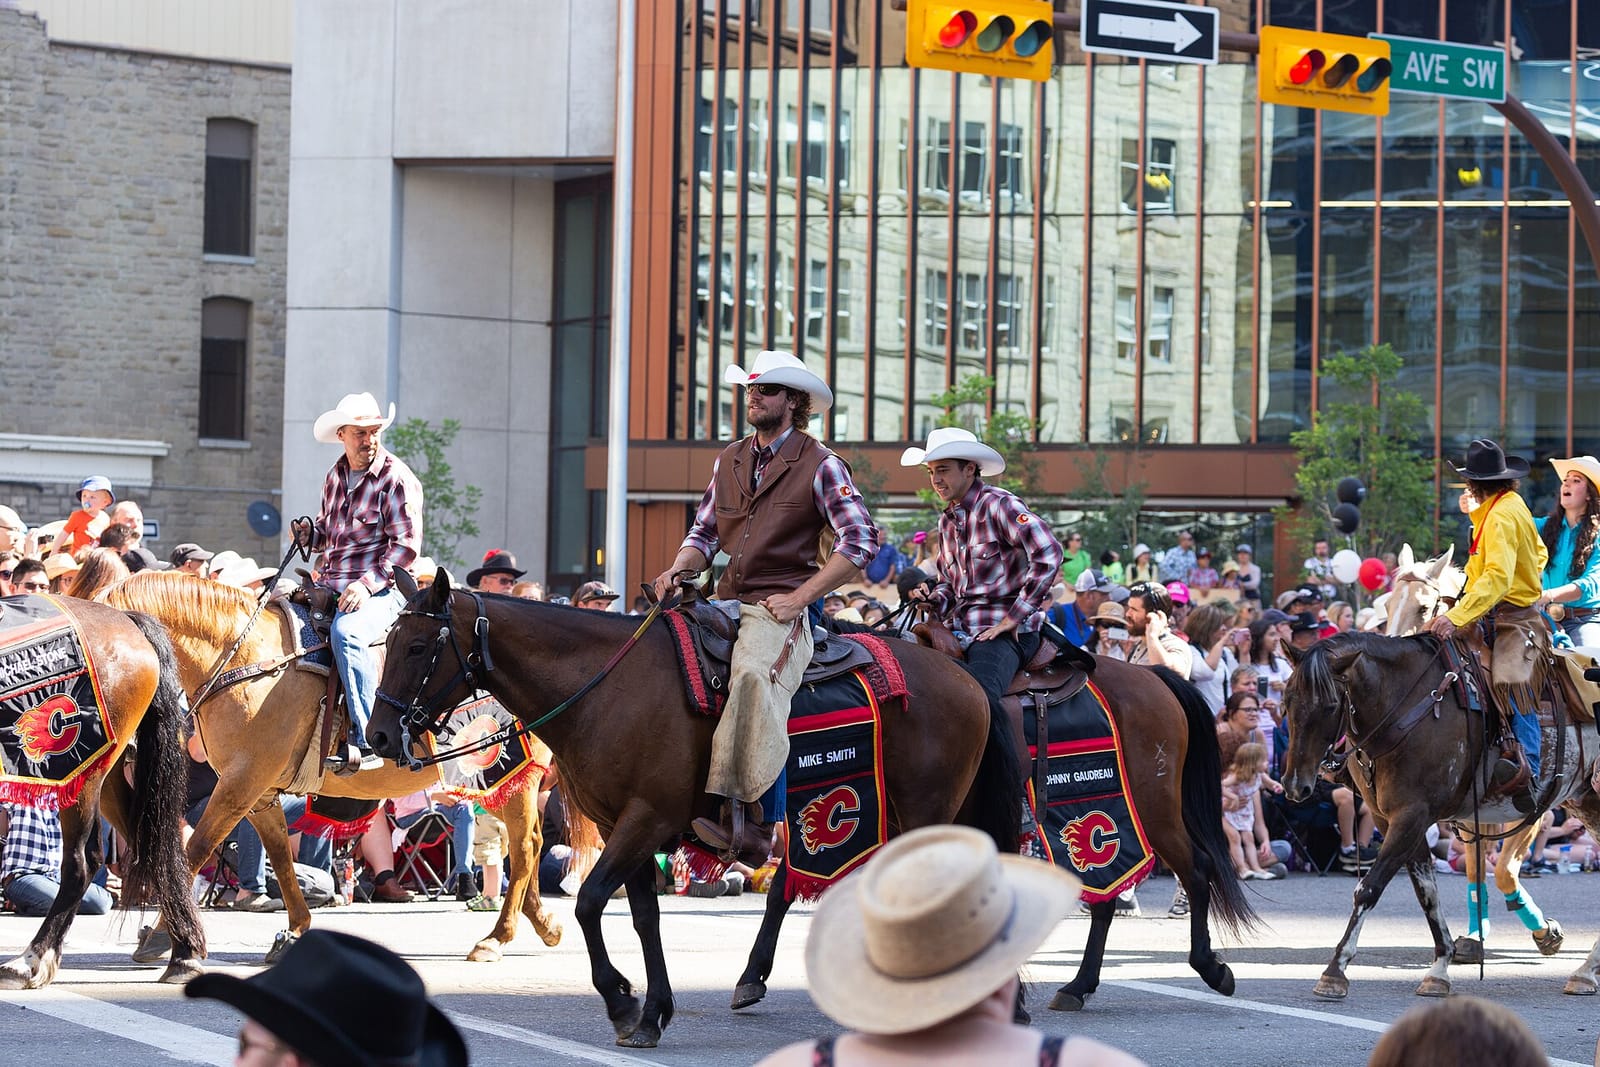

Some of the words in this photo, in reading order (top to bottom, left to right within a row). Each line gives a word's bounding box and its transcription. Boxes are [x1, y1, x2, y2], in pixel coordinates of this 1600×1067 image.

[1403, 51, 1449, 84] AVE
[1463, 57, 1497, 90] SW
[36, 647, 67, 667] STONE
[798, 753, 823, 768] MIKE
[826, 747, 856, 763] SMITH
[1073, 768, 1114, 782] GAUDREAU
